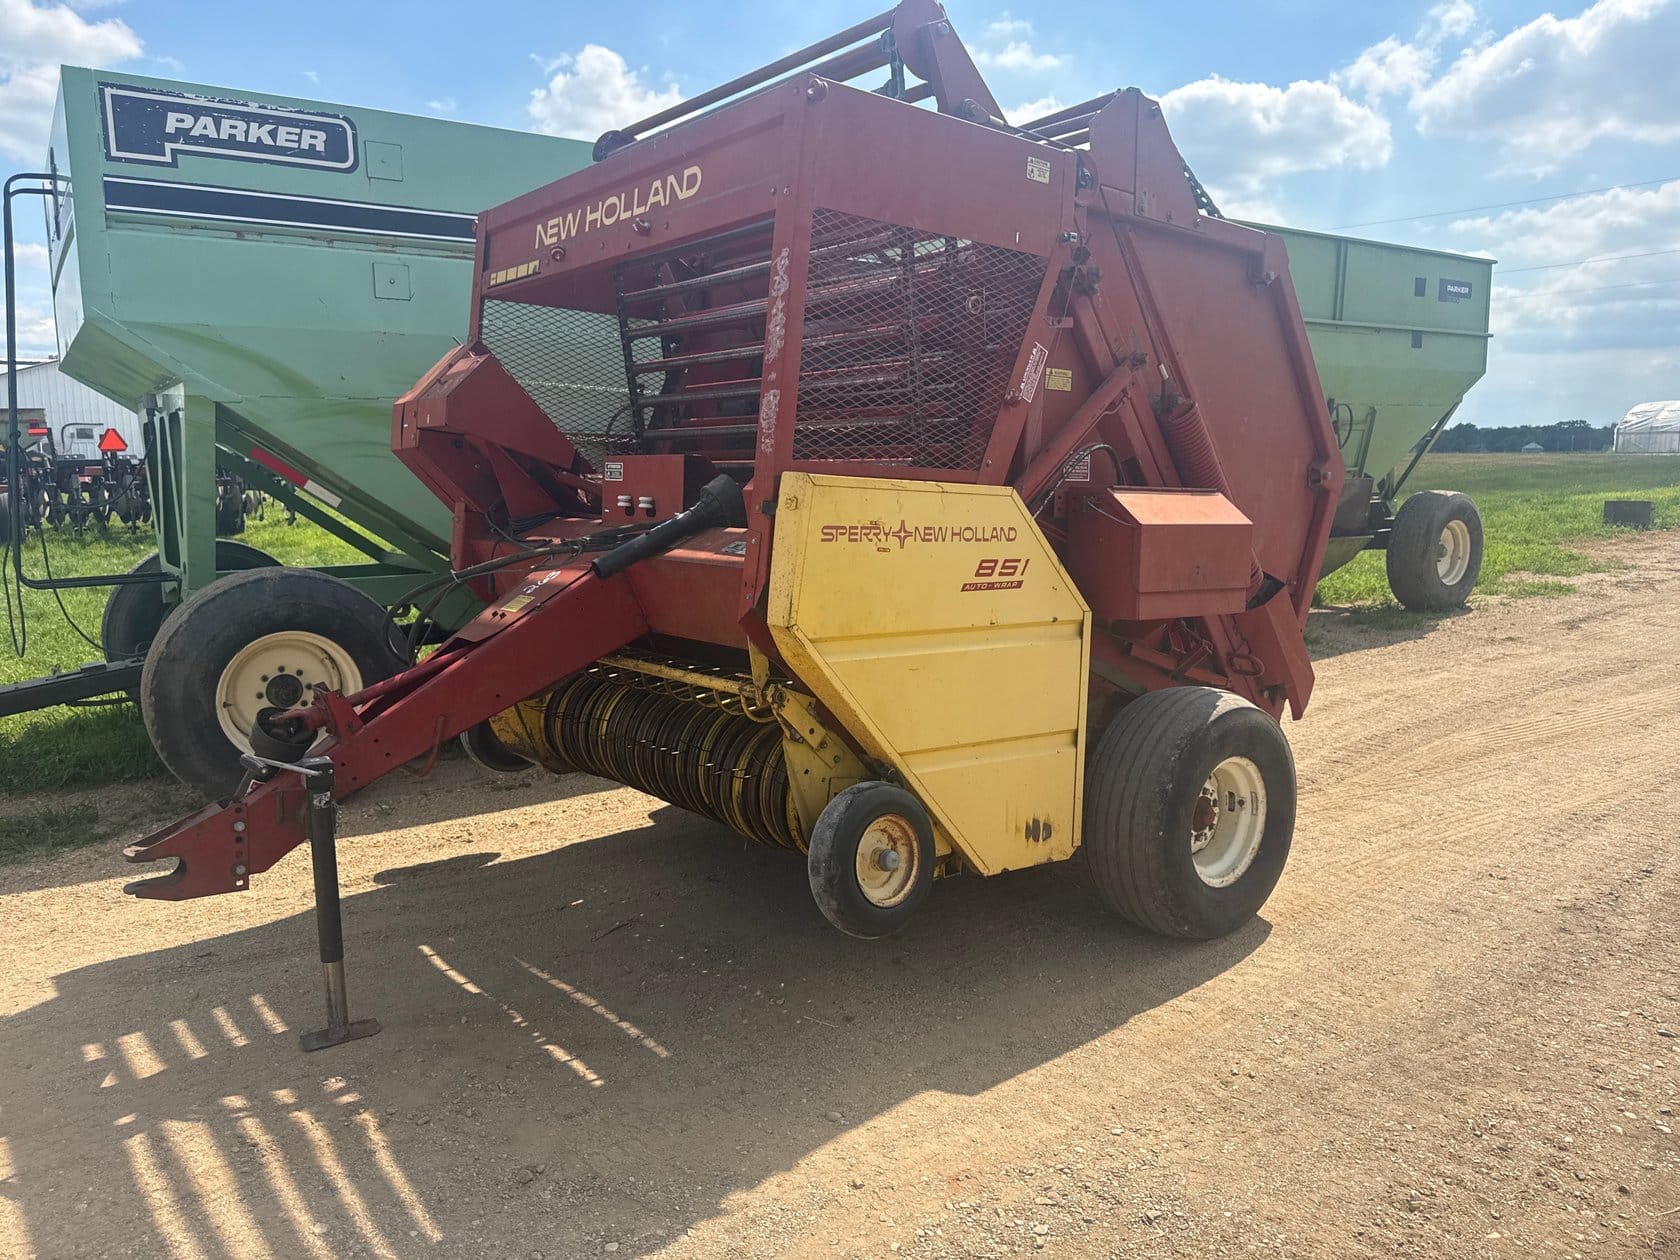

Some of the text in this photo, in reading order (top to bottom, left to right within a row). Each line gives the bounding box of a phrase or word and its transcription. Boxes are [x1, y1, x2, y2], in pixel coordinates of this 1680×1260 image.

[165, 112, 327, 152] PARKER
[535, 165, 702, 249] NEW HOLLAND
[821, 525, 1018, 543] SPERRY NEW HOLLAND
[975, 559, 1031, 577] 851
